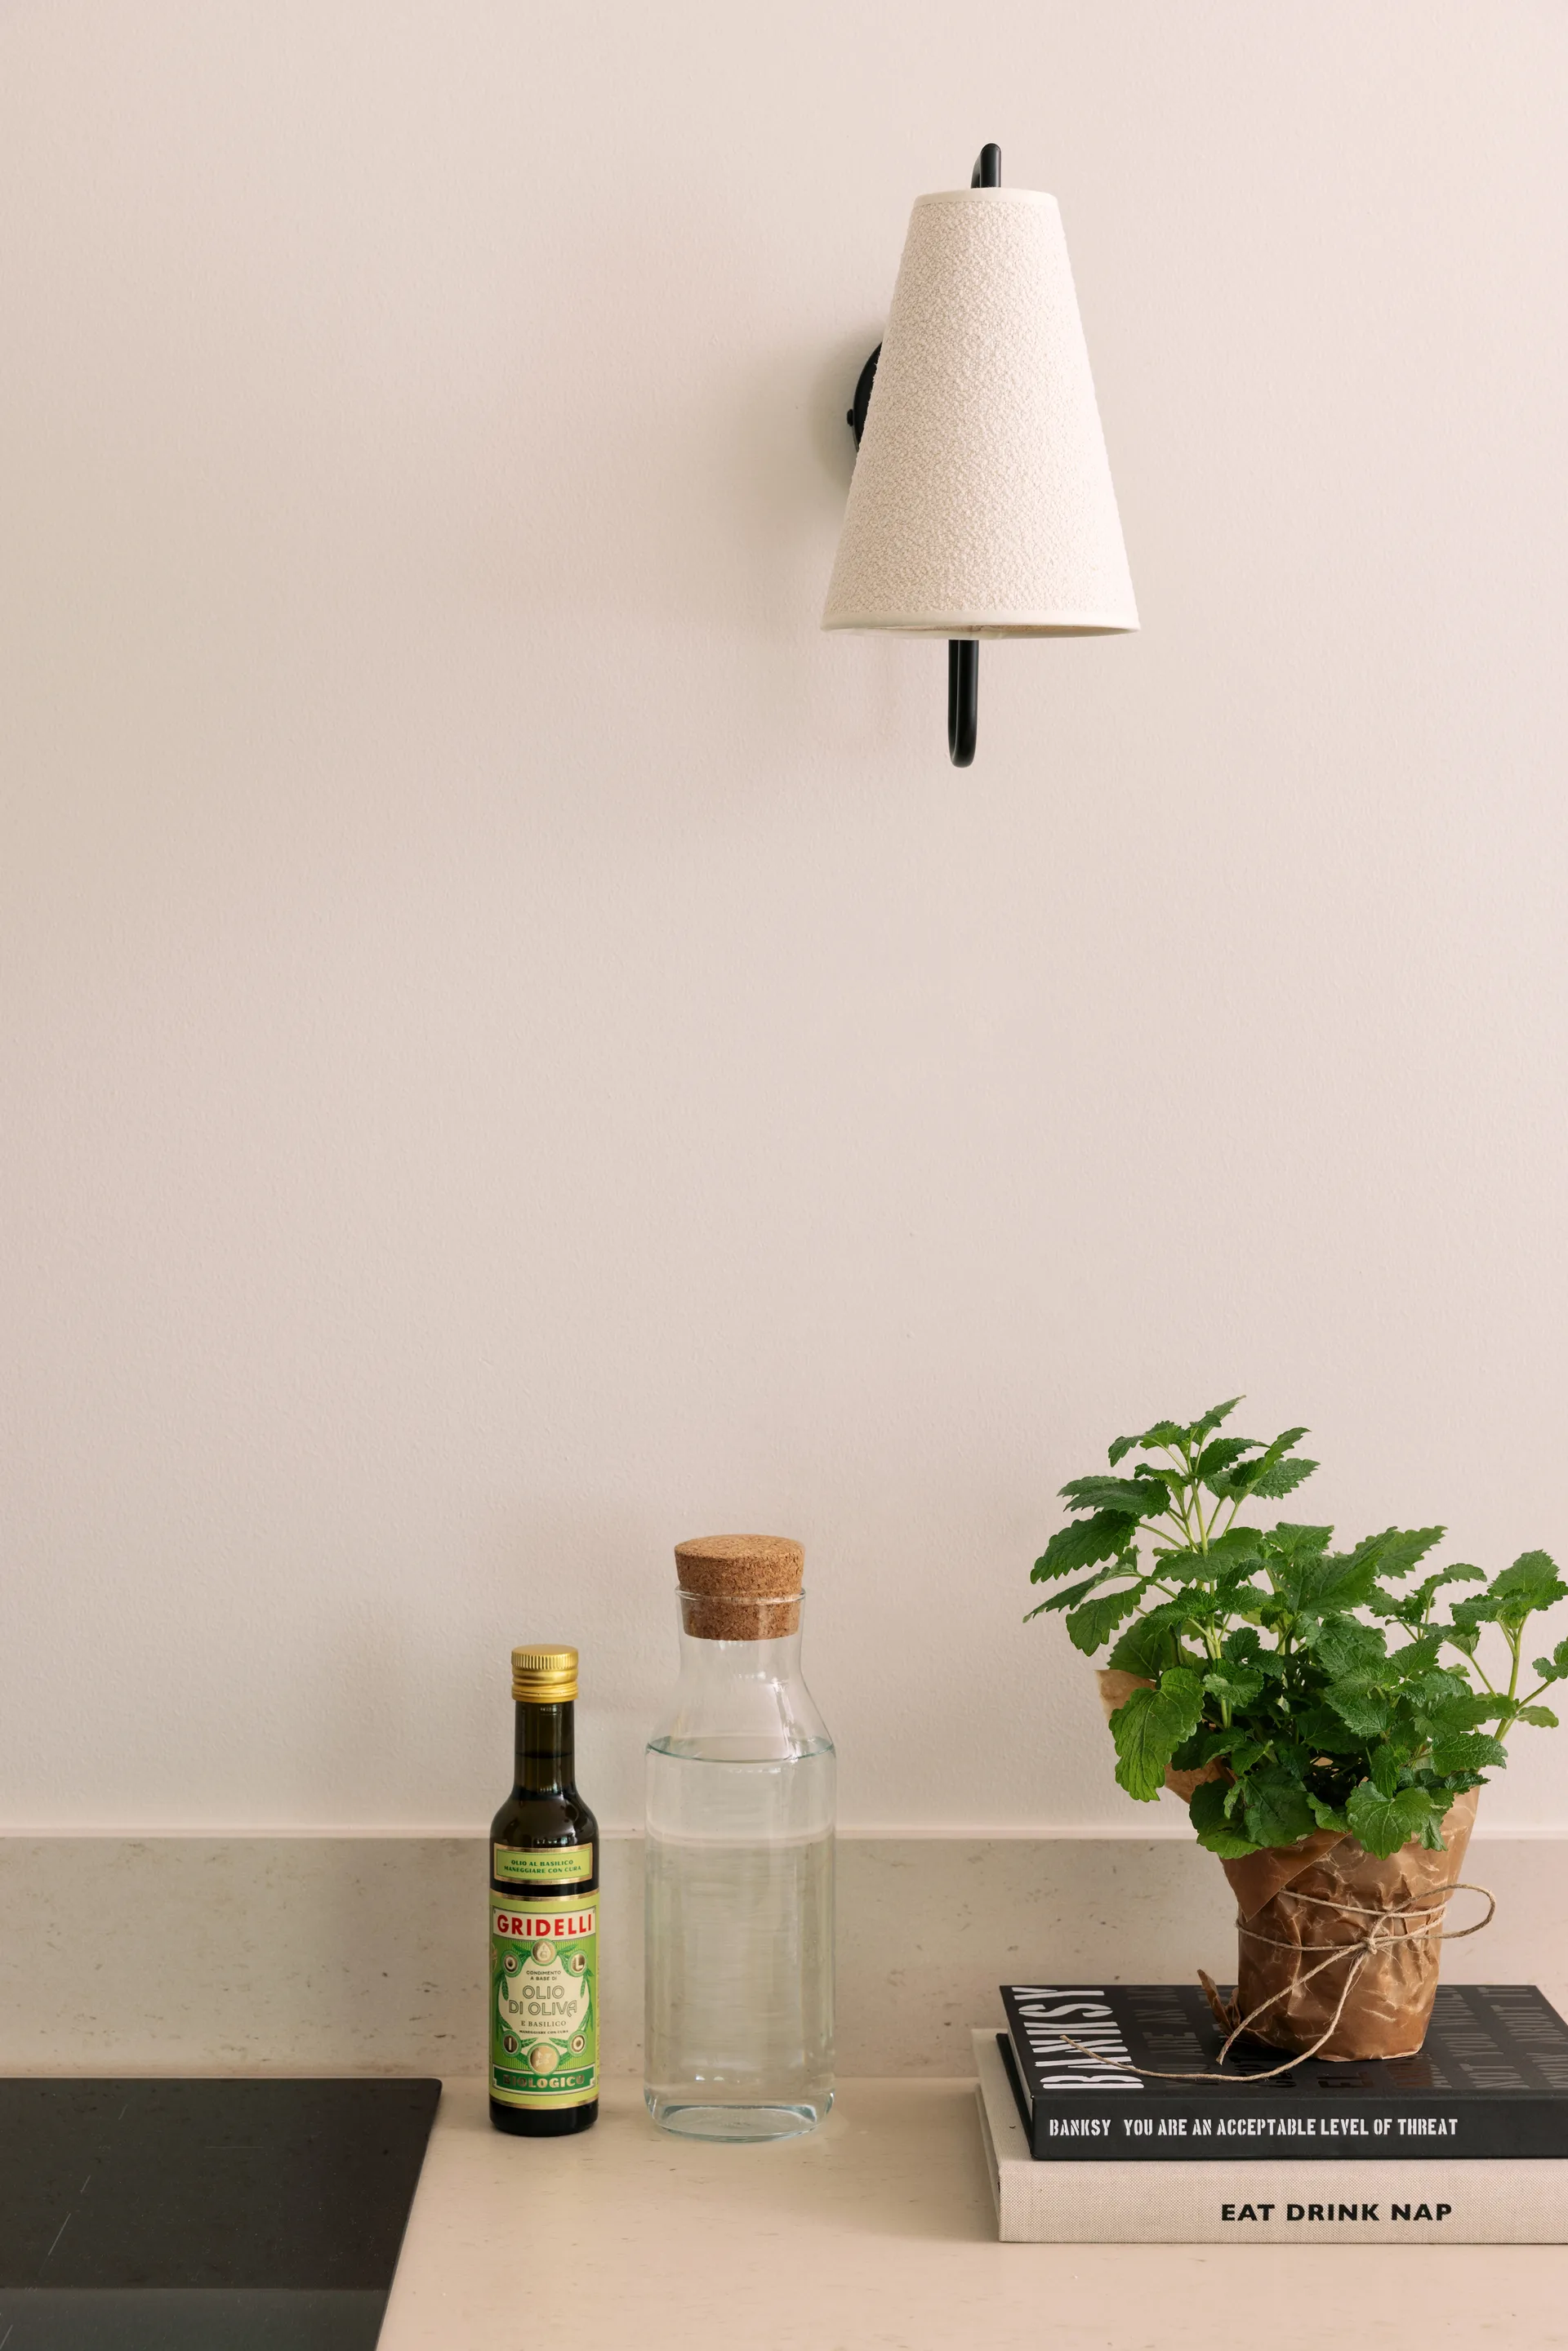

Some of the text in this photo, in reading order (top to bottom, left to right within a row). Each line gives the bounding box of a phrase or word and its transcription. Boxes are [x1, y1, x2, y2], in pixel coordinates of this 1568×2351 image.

[504, 1865, 546, 1873] MANEGGIARE
[497, 1913, 592, 1937] GRIDELLI
[522, 1984, 565, 2000] OLIO
[508, 1999, 577, 2018] DI OLIVA
[1011, 1986, 1145, 2090] BANKSY
[503, 2073, 585, 2089] BIOLOGICO
[1049, 2118, 1459, 2136] BANKSY YOU ARE AN ACCEPTABLE LEVEL OF THREAT
[1221, 2203, 1453, 2221] EAT DRINK NAP
